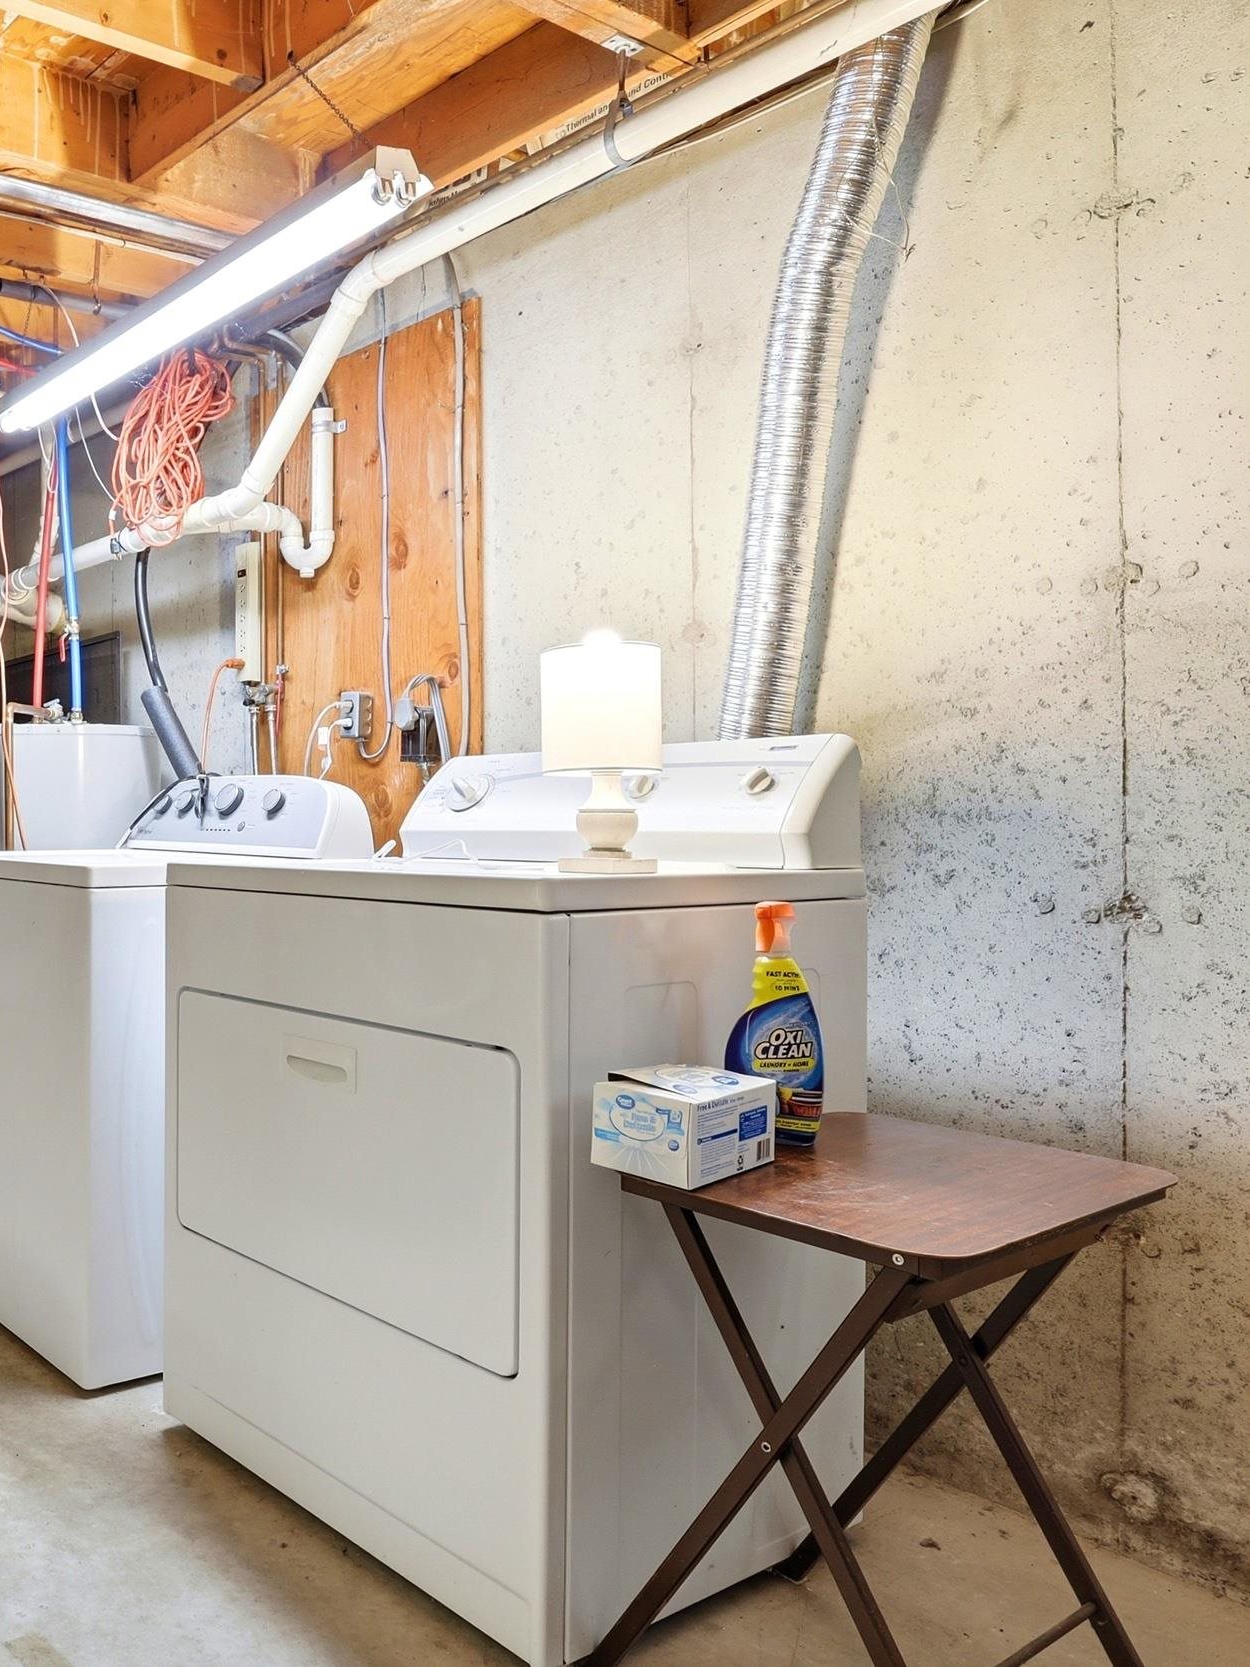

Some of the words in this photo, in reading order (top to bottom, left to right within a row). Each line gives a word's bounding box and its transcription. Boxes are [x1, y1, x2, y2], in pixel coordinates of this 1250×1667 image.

[565, 108, 598, 131] Thermal
[769, 1028, 804, 1046] OXI
[754, 1041, 814, 1060] CLEAN
[759, 1061, 787, 1069] LAUNDRY
